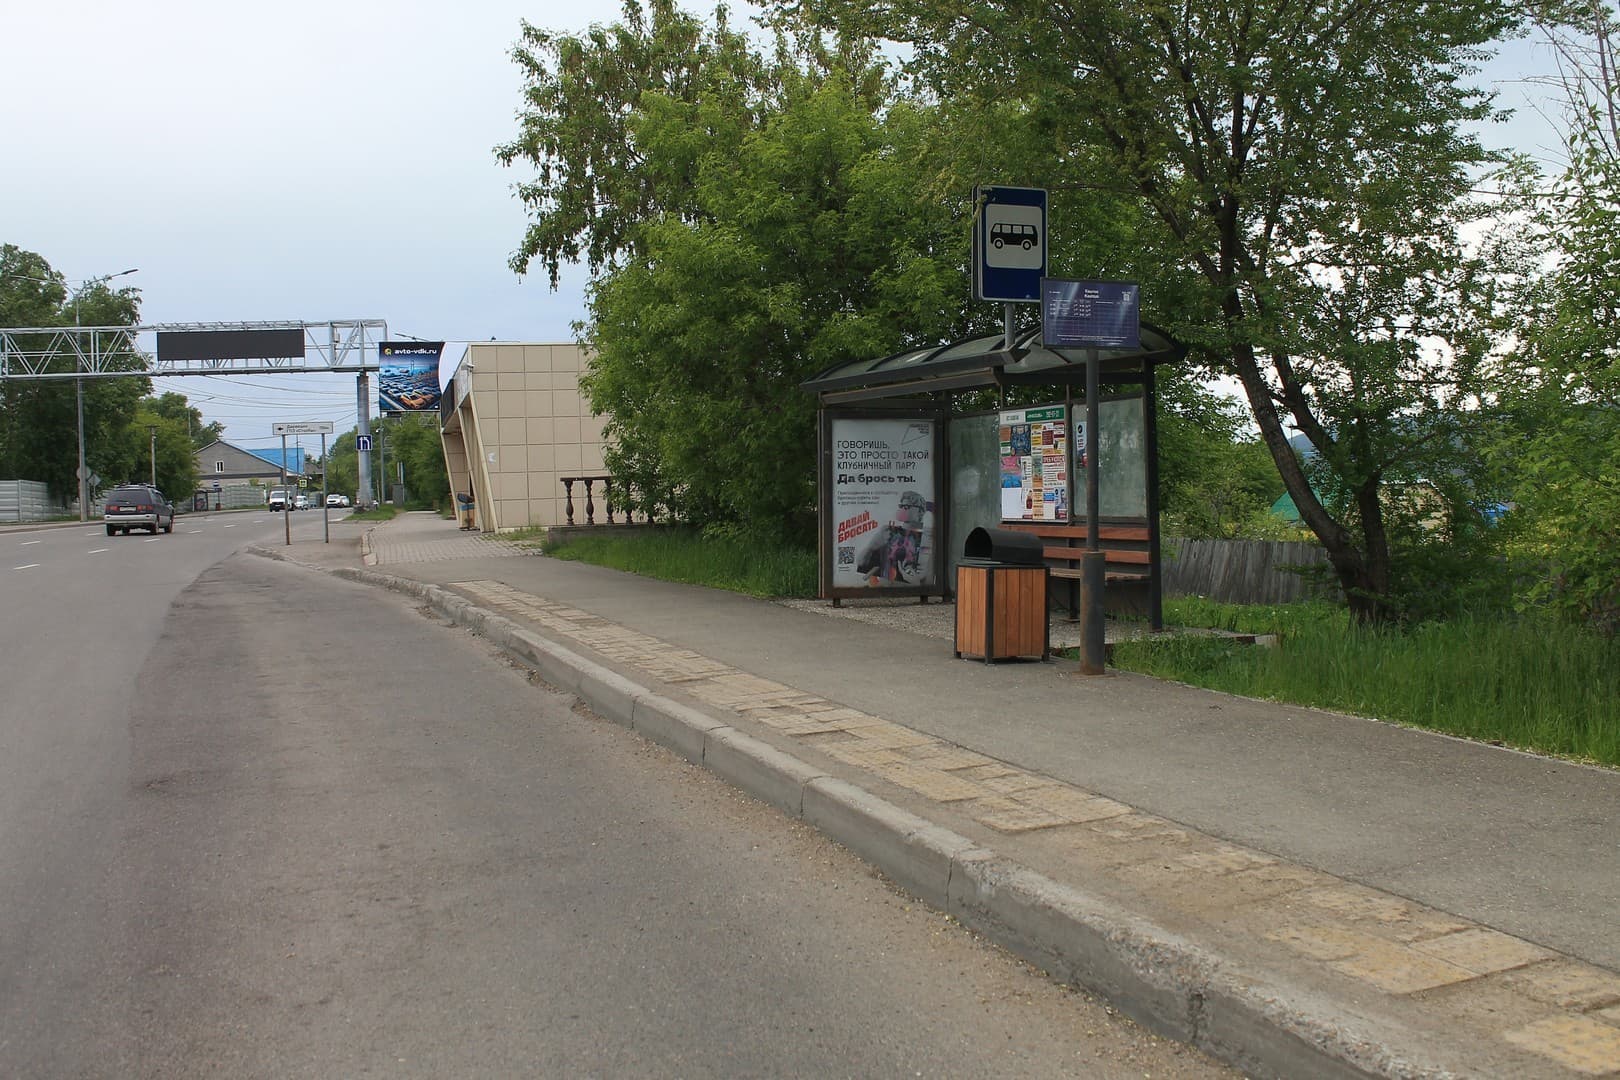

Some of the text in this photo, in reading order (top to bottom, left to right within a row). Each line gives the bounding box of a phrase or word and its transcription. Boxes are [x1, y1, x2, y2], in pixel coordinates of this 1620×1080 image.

[837, 440, 890, 449] ГОВОРИШЬ,
[837, 450, 929, 460] ЭТО ПРОСТО ТАКОЙ
[837, 460, 916, 470] КЛУБНИЧНЫЙ ПАР?
[837, 473, 916, 485] Да брось ты.
[838, 510, 870, 533] ДАВАЙ
[837, 520, 879, 543] БРОСАТЬ
